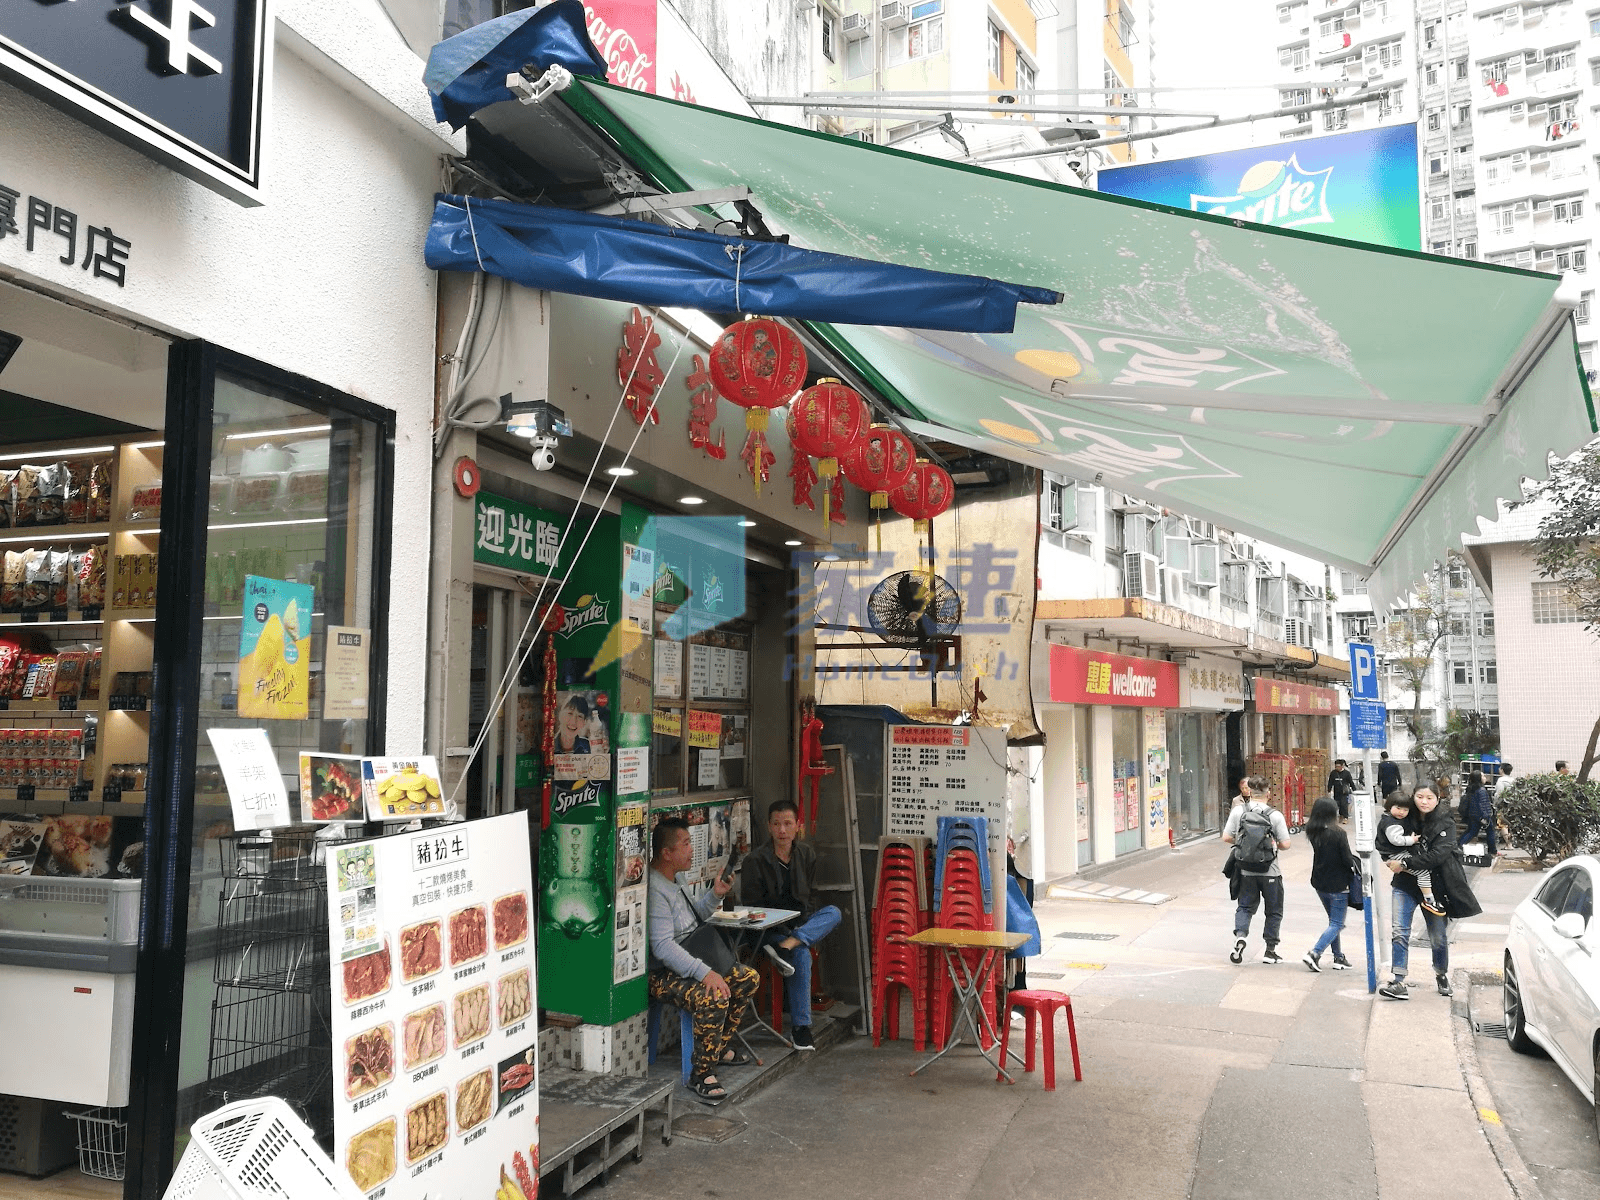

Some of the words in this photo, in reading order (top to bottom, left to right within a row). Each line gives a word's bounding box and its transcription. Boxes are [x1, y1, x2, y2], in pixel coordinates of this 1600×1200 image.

[477, 502, 560, 568] 迎光臨
[1086, 661, 1112, 694] 惠康
[1113, 667, 1157, 698] wellcome
[1354, 648, 1372, 693] P
[554, 785, 598, 813] Sprite
[416, 834, 464, 864] 豬扮牛
